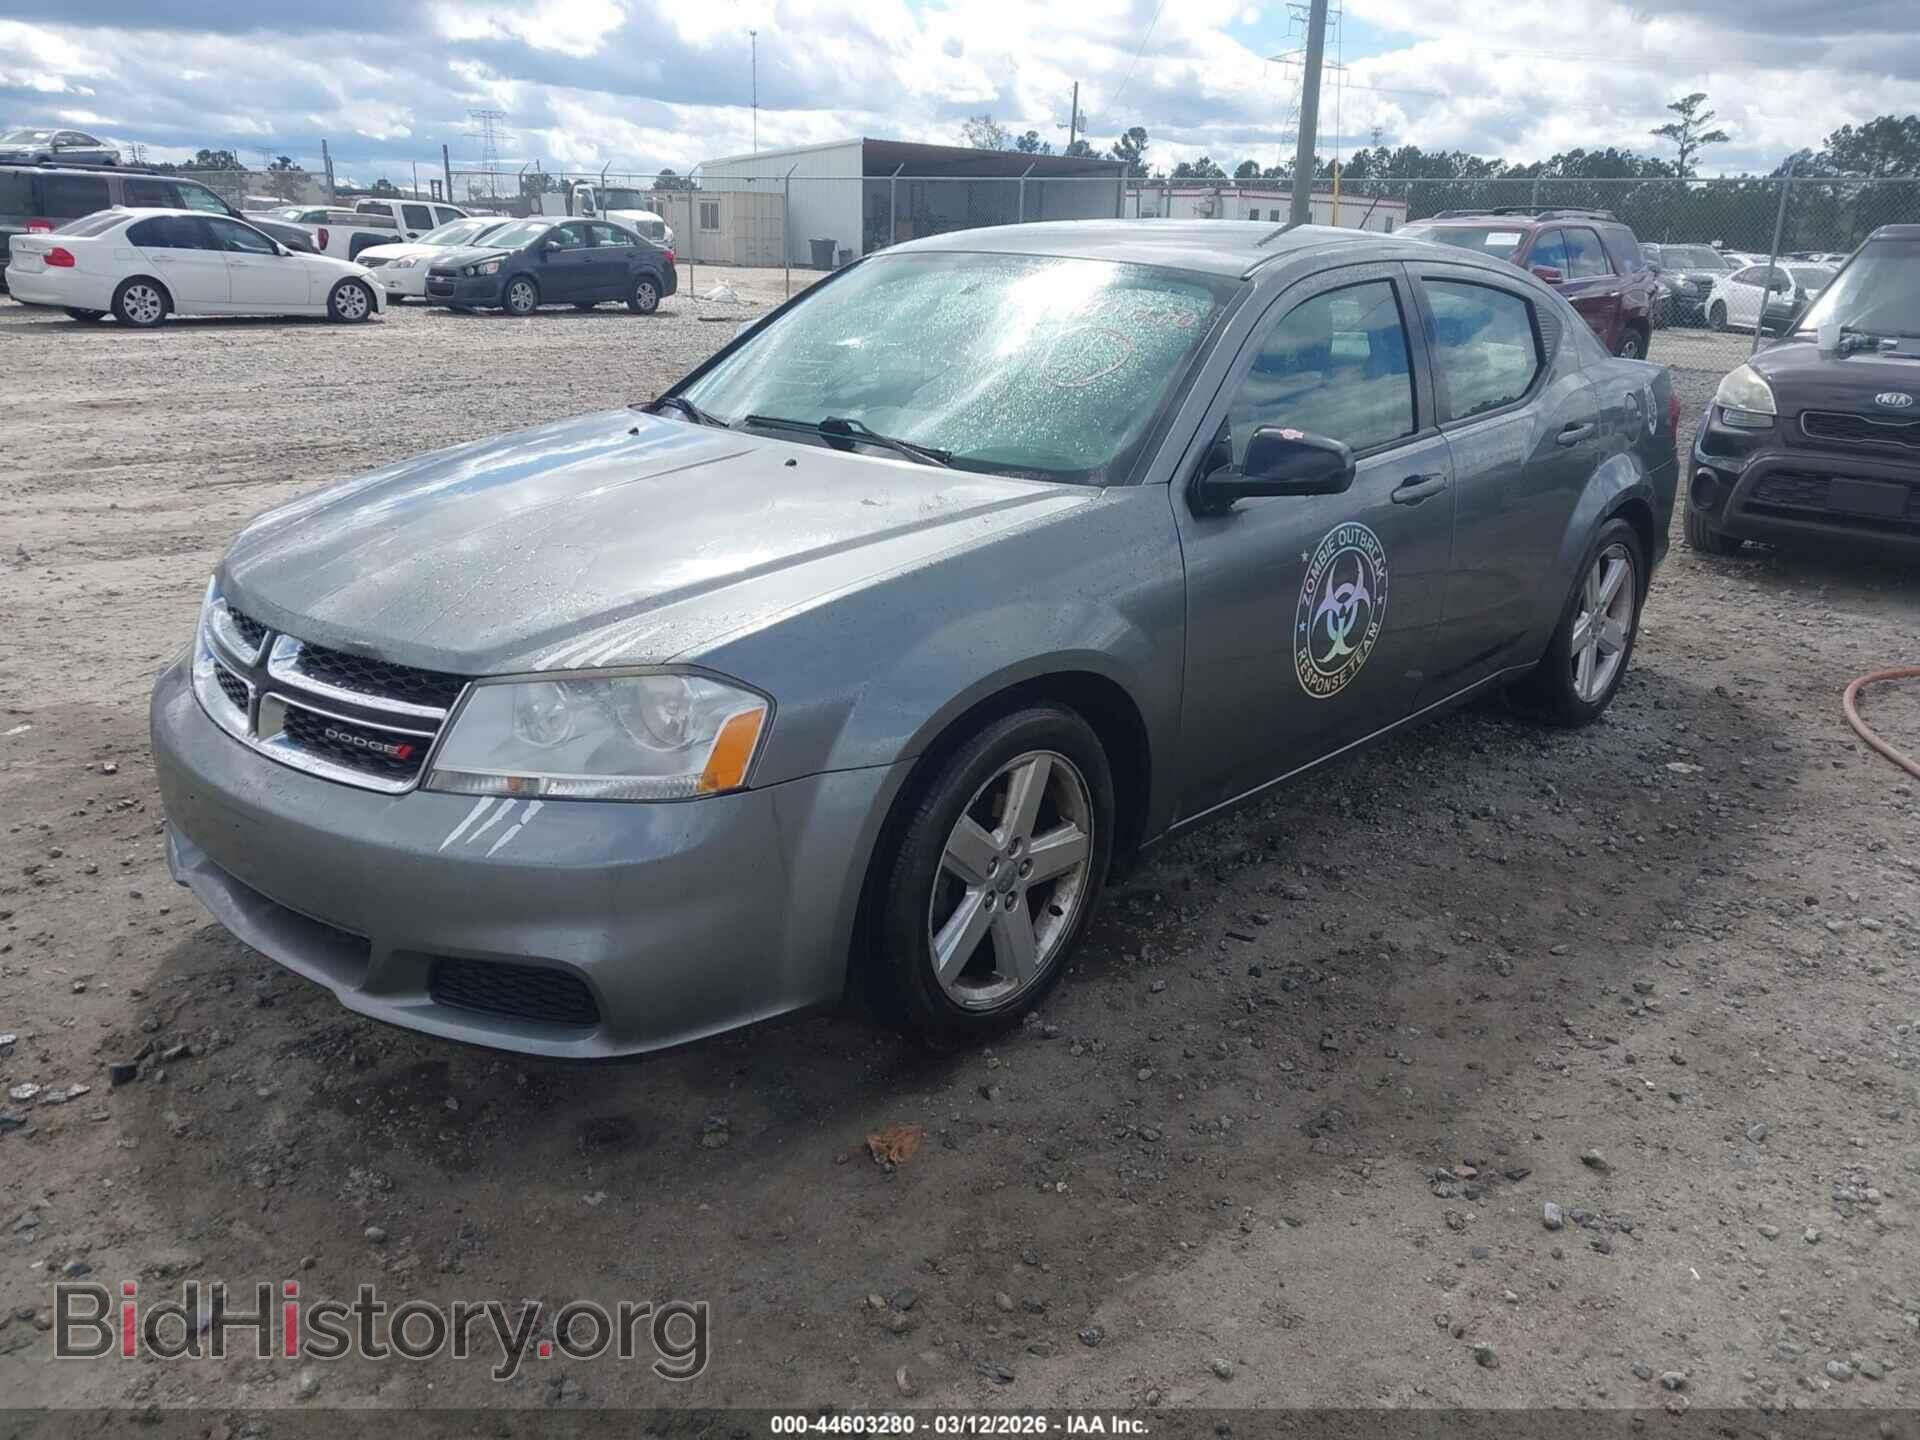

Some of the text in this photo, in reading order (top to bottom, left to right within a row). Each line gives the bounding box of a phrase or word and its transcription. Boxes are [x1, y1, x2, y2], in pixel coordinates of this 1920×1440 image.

[1878, 393, 1908, 405] KIA
[1301, 527, 1387, 607] ZOMBIE OUTBREAK
[1297, 621, 1379, 693] RESPONSE TEAM
[324, 727, 398, 754] DODGE
